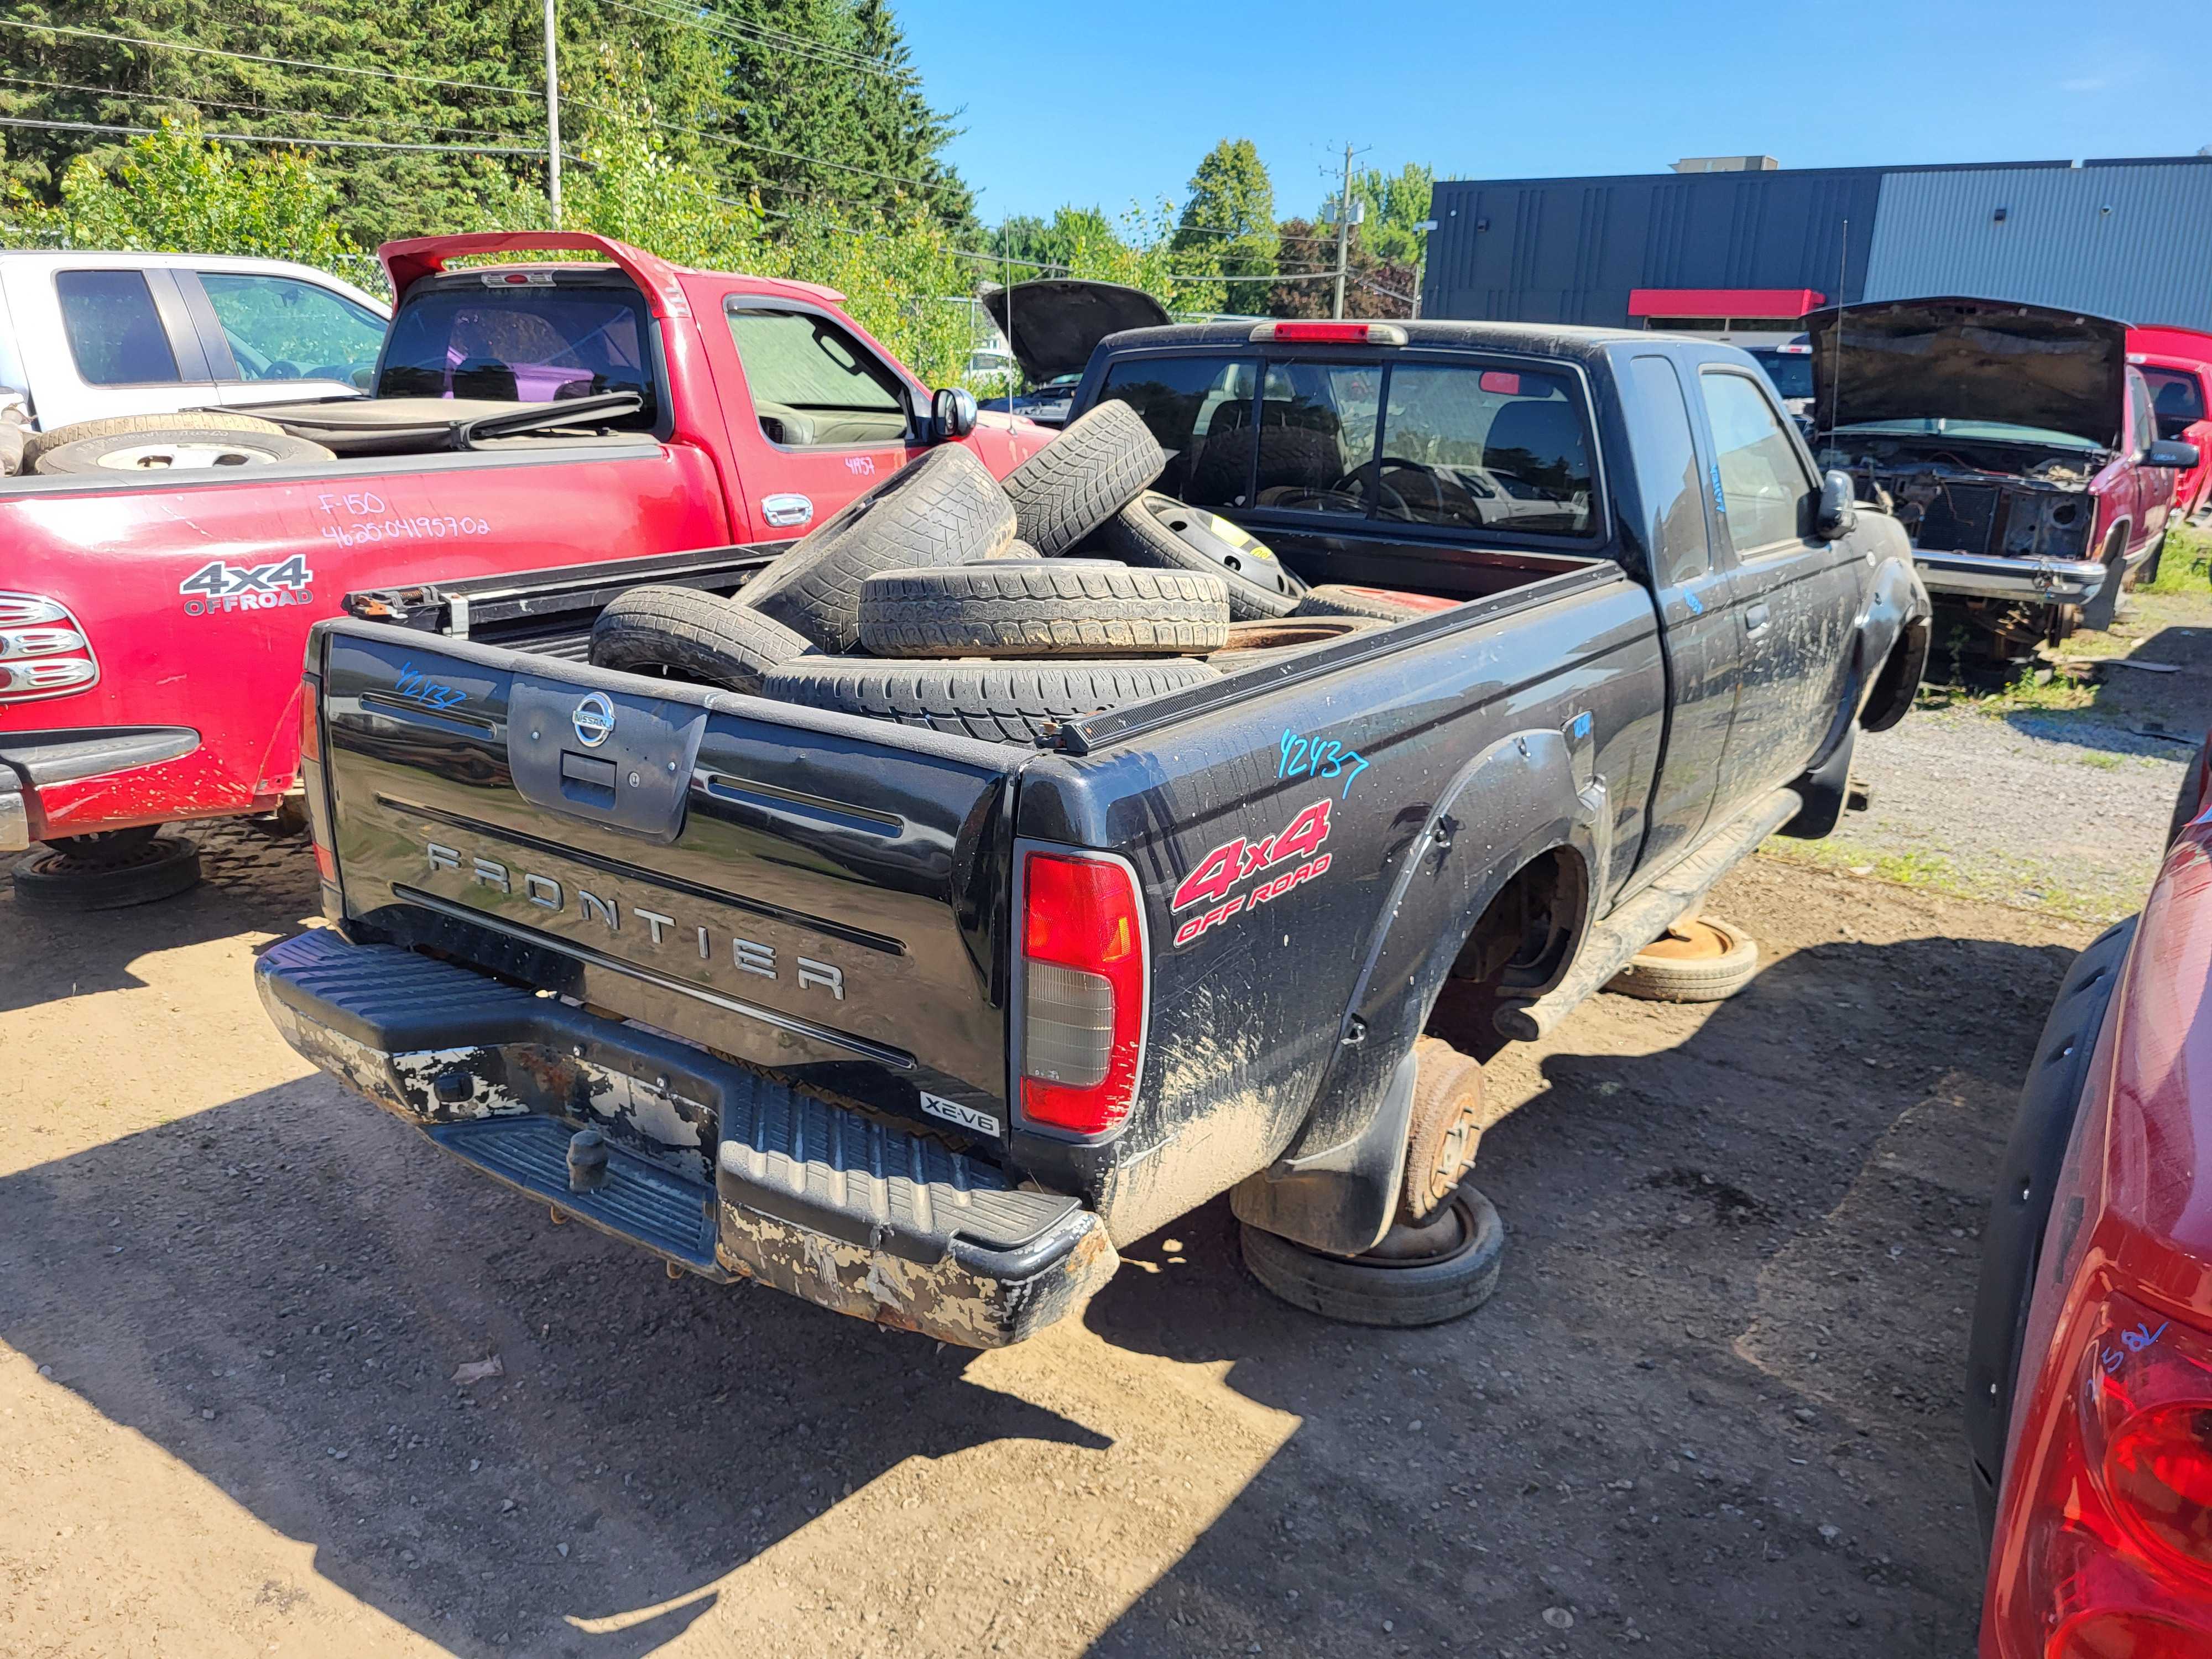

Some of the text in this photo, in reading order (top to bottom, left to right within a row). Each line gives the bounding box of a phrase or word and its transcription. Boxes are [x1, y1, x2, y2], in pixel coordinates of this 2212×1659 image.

[318, 492, 385, 515] F-150
[180, 554, 313, 598] 4x4
[184, 589, 314, 616] OFFROAD
[575, 712, 607, 728] NISSAN
[1171, 797, 1333, 915] 4x4
[1173, 853, 1333, 948] OFF ROAD
[427, 842, 845, 1001] FRONTIER
[925, 1096, 994, 1131] XE-V6
